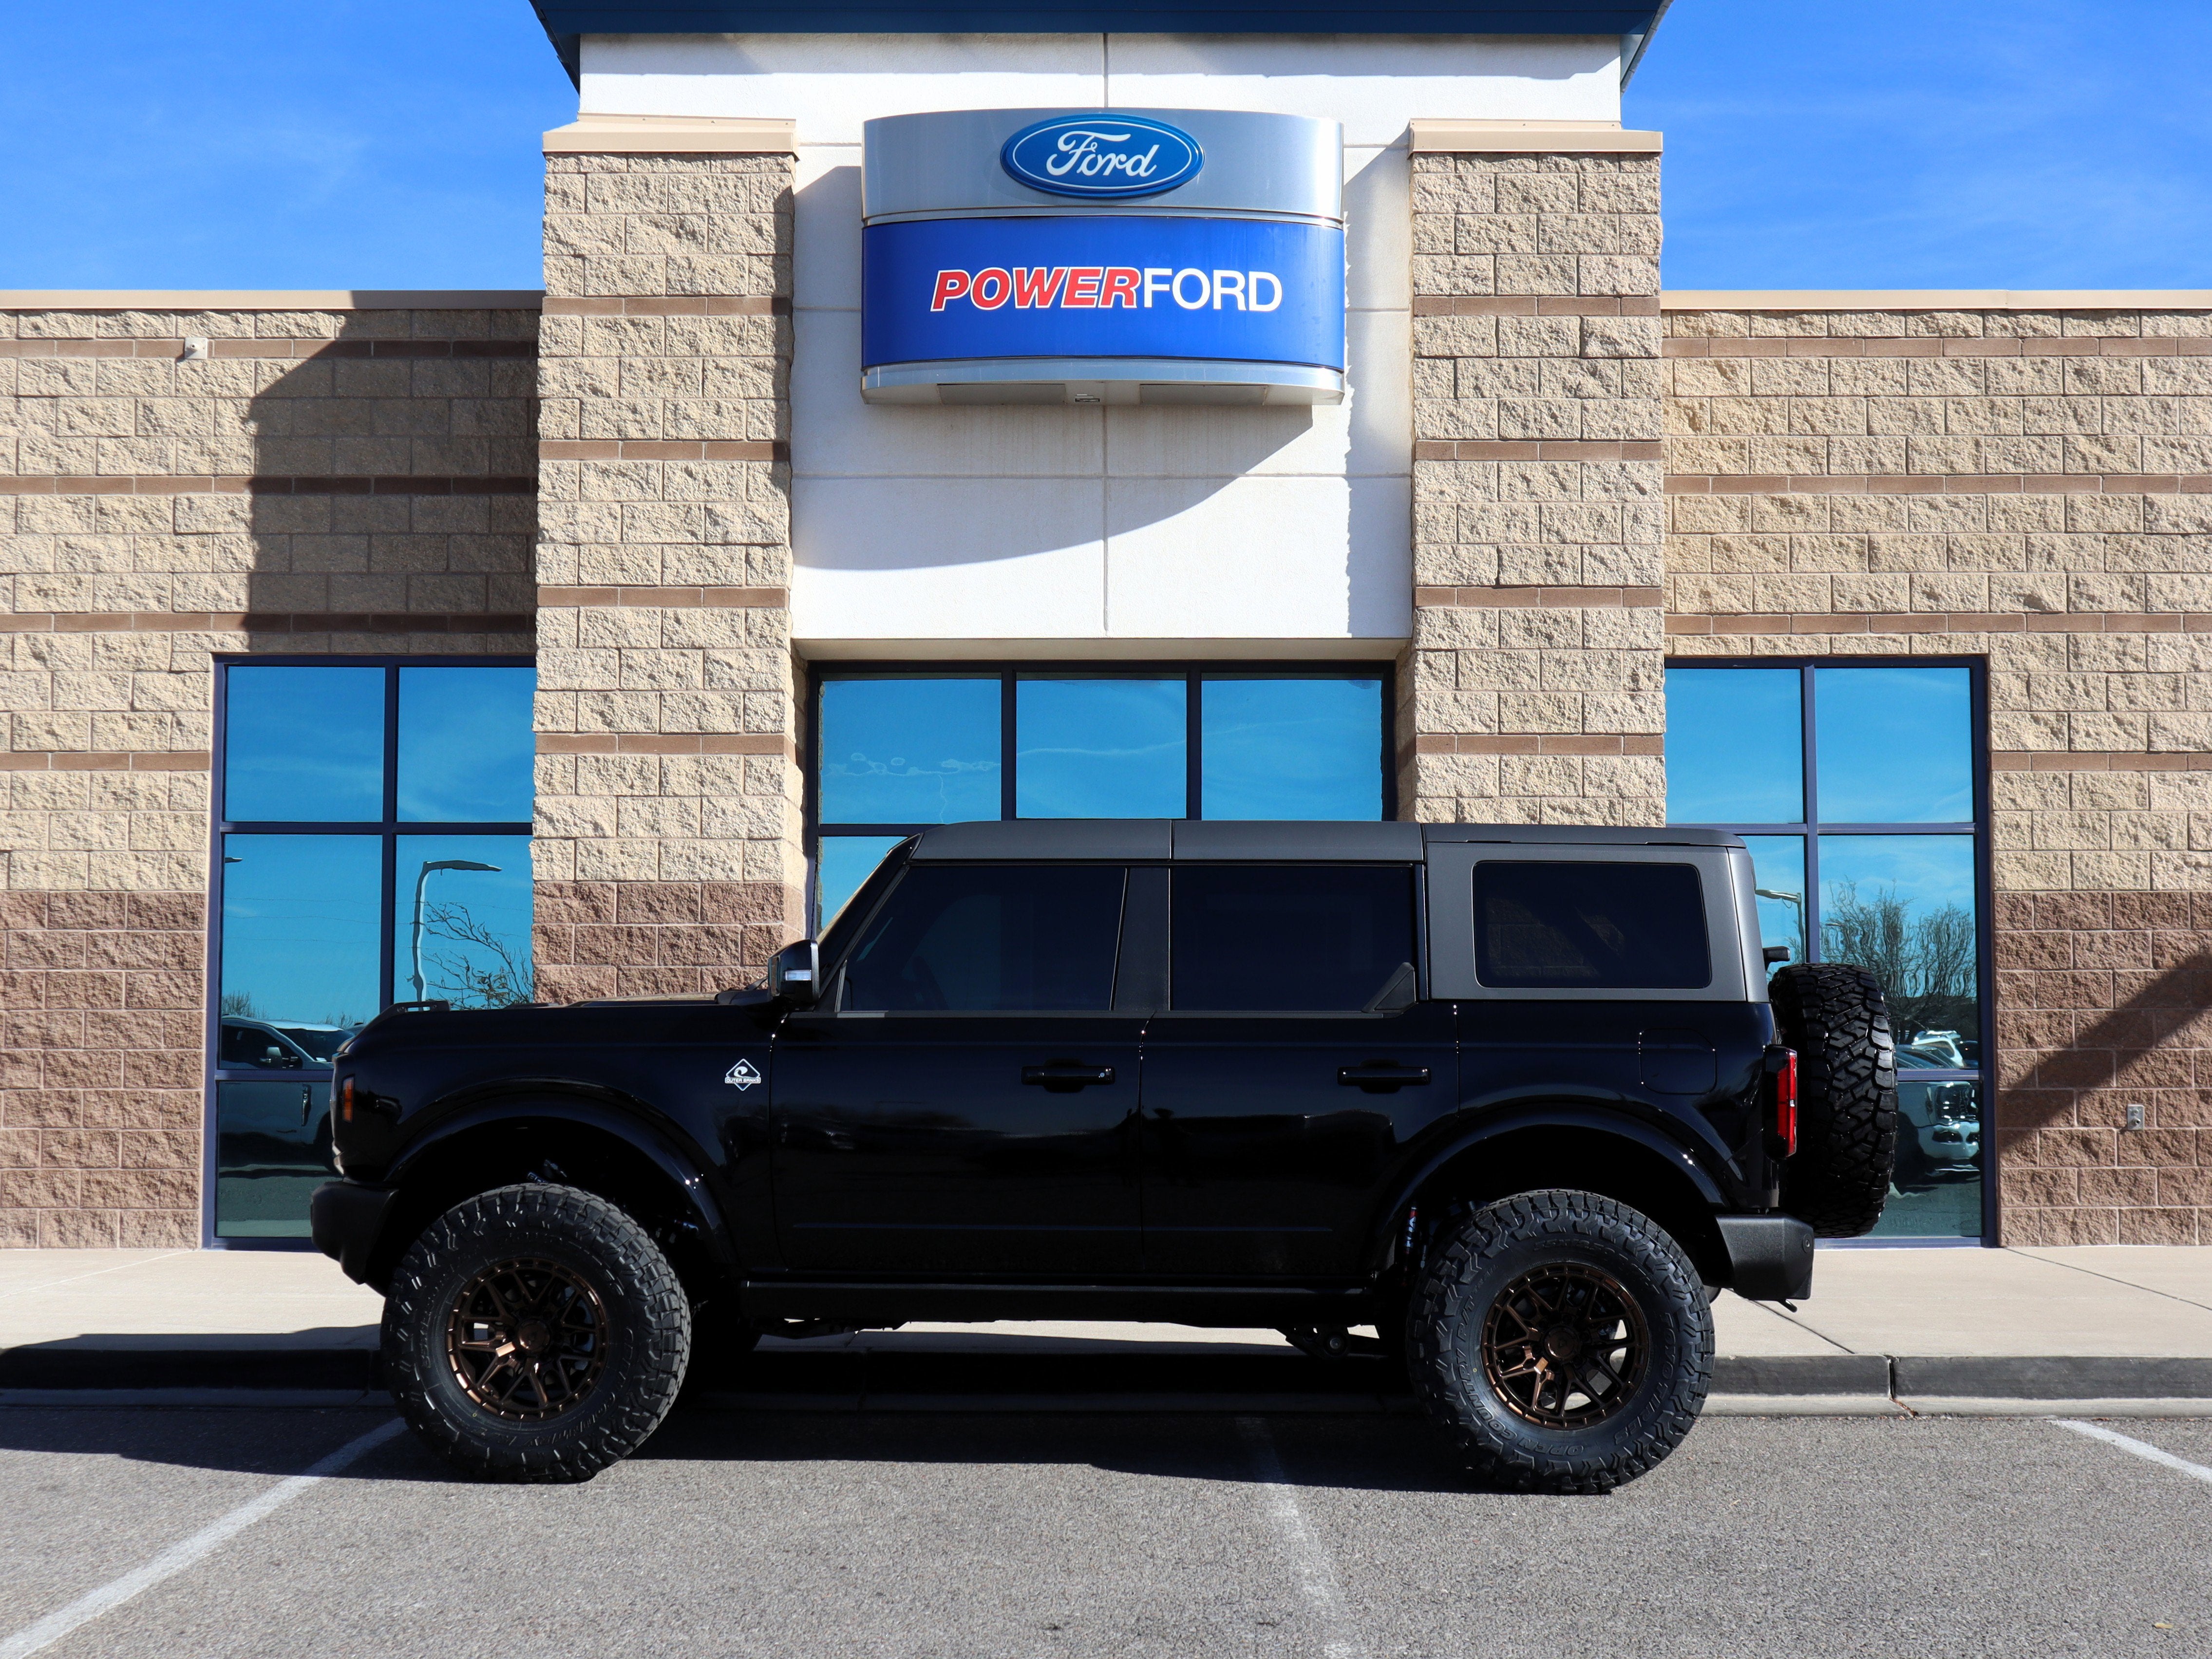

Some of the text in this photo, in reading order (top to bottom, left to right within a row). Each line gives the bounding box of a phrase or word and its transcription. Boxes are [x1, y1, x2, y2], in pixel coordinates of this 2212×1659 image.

[1046, 131, 1160, 177] Ford
[930, 266, 1283, 312] POWERFORD
[1456, 1347, 1518, 1441] COUNTRY
[1517, 1437, 1585, 1456] OPEN
